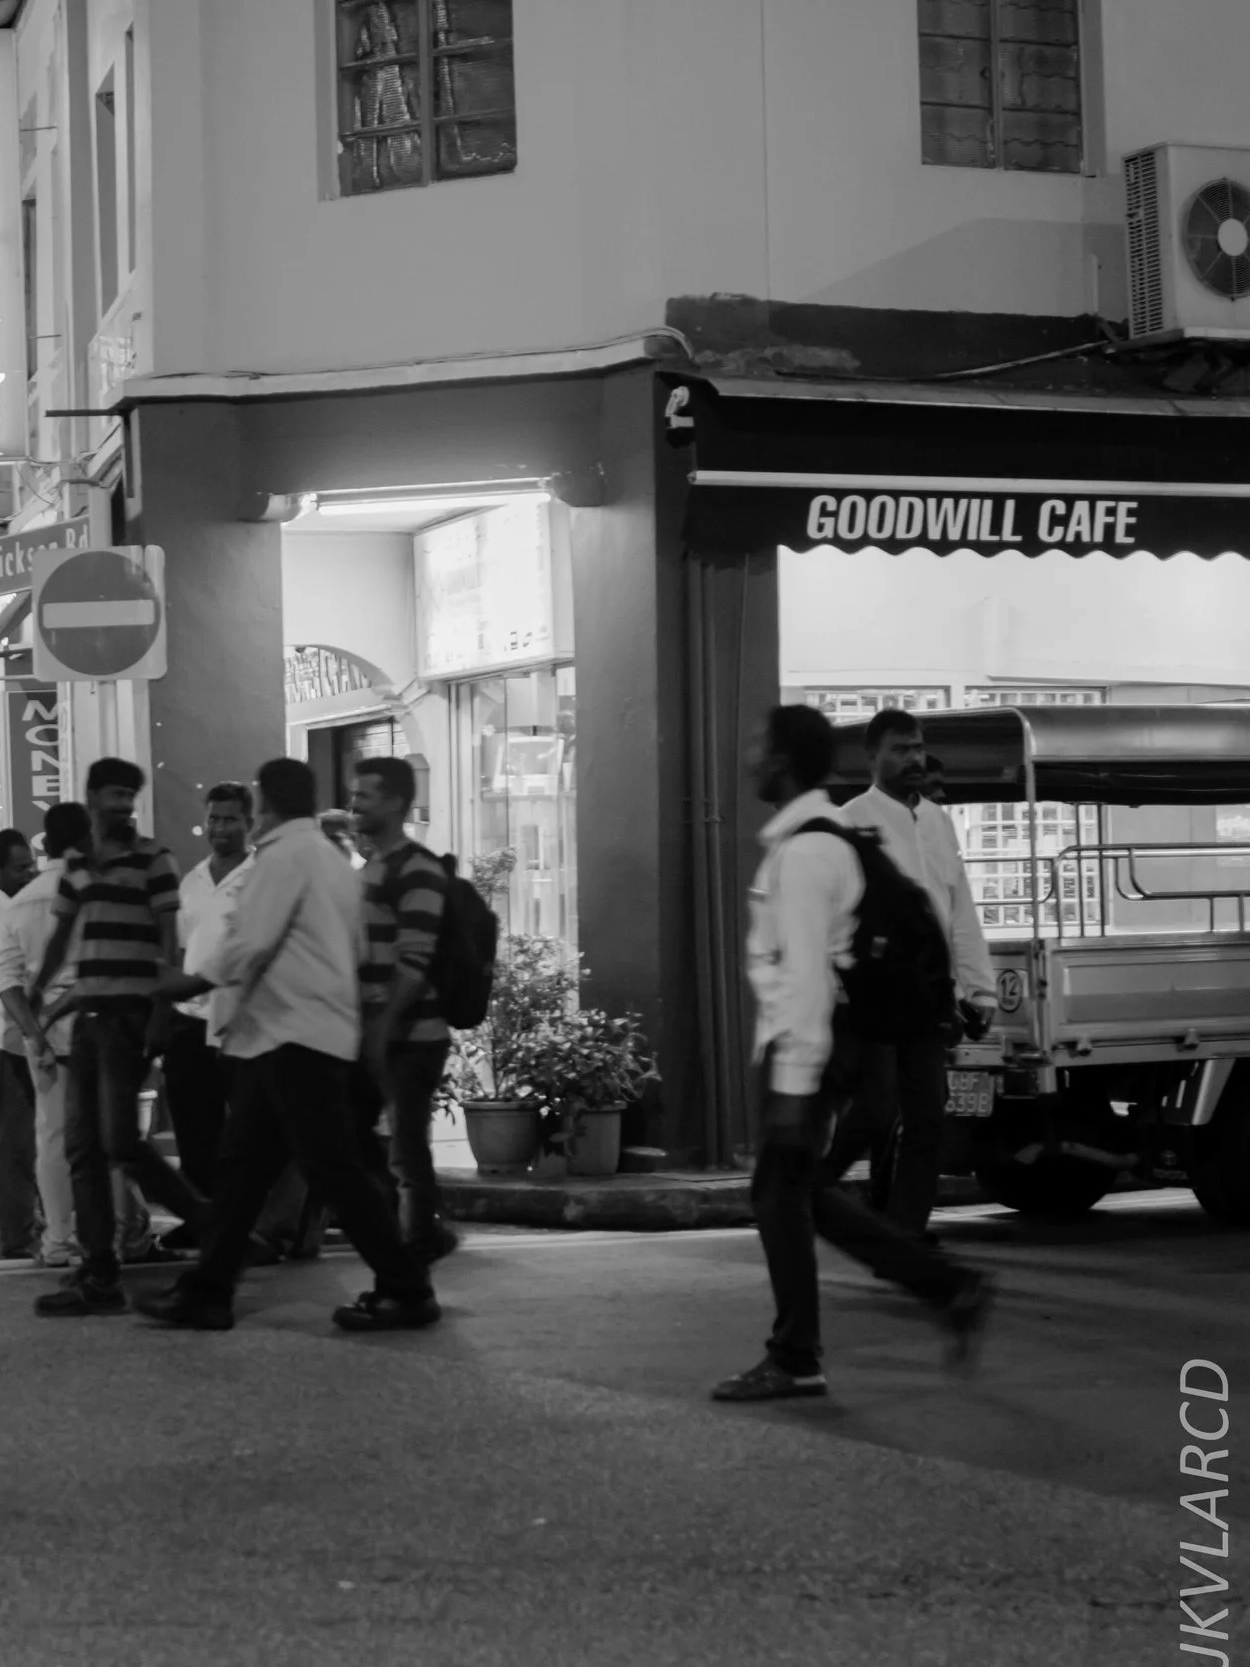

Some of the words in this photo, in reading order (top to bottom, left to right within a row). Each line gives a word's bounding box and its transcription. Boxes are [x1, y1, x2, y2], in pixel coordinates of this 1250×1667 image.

[665, 386, 694, 428] 2
[806, 494, 1023, 543] GOODWILL
[1037, 498, 1139, 544] CAFE
[21, 699, 61, 812] MONE
[1001, 976, 1018, 996] 12
